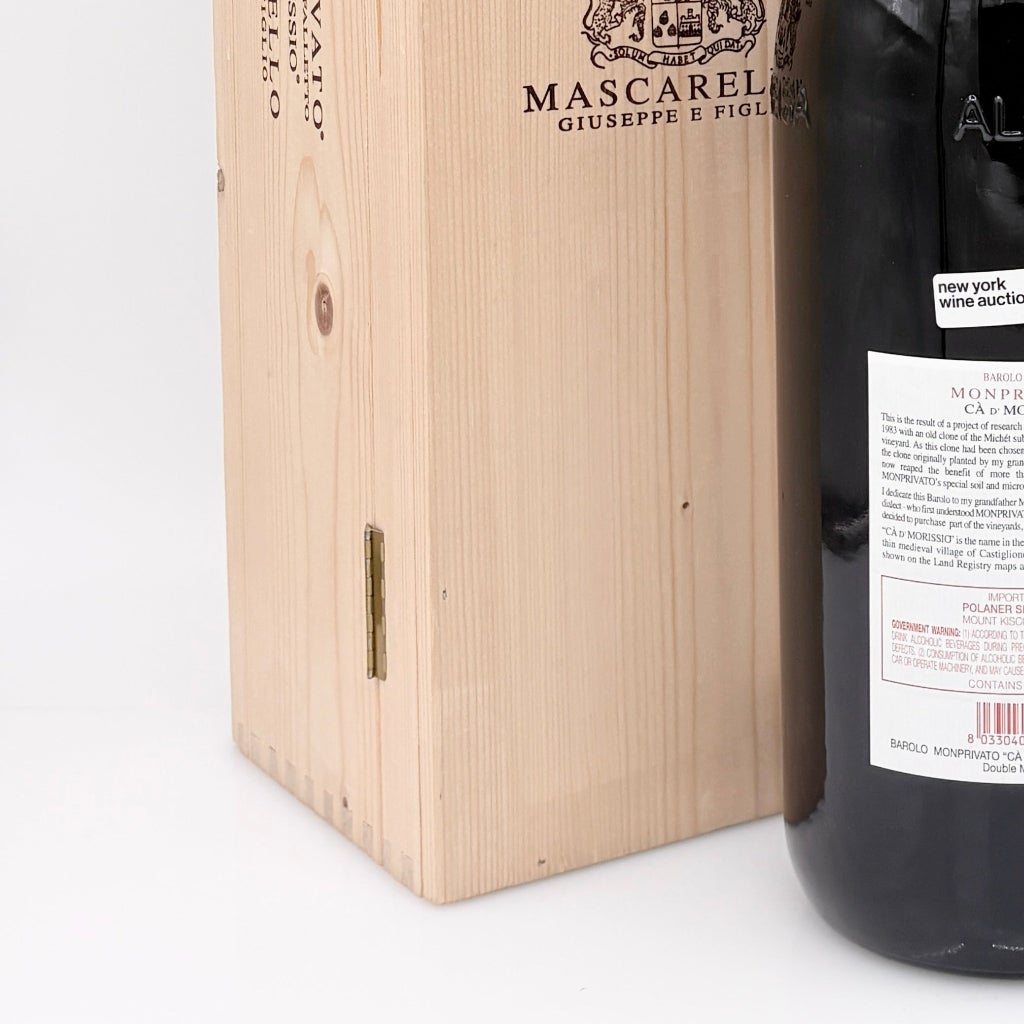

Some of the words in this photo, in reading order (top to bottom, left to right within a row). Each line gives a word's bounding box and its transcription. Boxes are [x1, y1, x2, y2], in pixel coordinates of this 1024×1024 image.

[613, 48, 649, 62] SOLUM
[662, 52, 697, 66] HABET
[558, 109, 678, 132] GIUSEPPE
[691, 107, 703, 121] E
[937, 282, 969, 294] new
[971, 277, 1007, 295] york
[939, 294, 975, 308] wine
[983, 372, 1022, 382] BAROLO
[964, 401, 984, 414] CÀ
[916, 418, 935, 426] result
[952, 422, 978, 431] project
[990, 422, 1022, 430] research
[898, 428, 913, 436] with
[938, 431, 958, 440] clone
[925, 442, 938, 450] this
[939, 443, 960, 452] clone
[978, 445, 996, 454] been
[892, 450, 911, 459] clone
[913, 454, 946, 465] originally
[949, 456, 976, 466] planted
[944, 467, 970, 476] benefit
[942, 480, 968, 489] special
[970, 481, 984, 489] soil
[985, 481, 1000, 489] and
[913, 492, 925, 500] this
[926, 493, 950, 503] Barolo
[974, 497, 1017, 507] grandfather
[914, 517, 946, 526] purchase
[898, 543, 932, 553] medieval
[936, 546, 963, 558] village
[882, 551, 905, 561] shown
[933, 557, 954, 567] Land
[956, 559, 991, 572] Registry
[994, 563, 1017, 572] maps
[962, 602, 1012, 613] POLANER
[962, 615, 996, 625] MOUNT
[891, 619, 929, 633] GOVERNMENT
[931, 625, 960, 637] WARNING:
[968, 679, 1022, 690] CONTAINS
[967, 733, 974, 743] 8
[980, 734, 1024, 745] 033040
[890, 738, 928, 754] BAROLO
[933, 746, 1000, 760] MONPRIVATO
[983, 762, 1016, 773] Double
